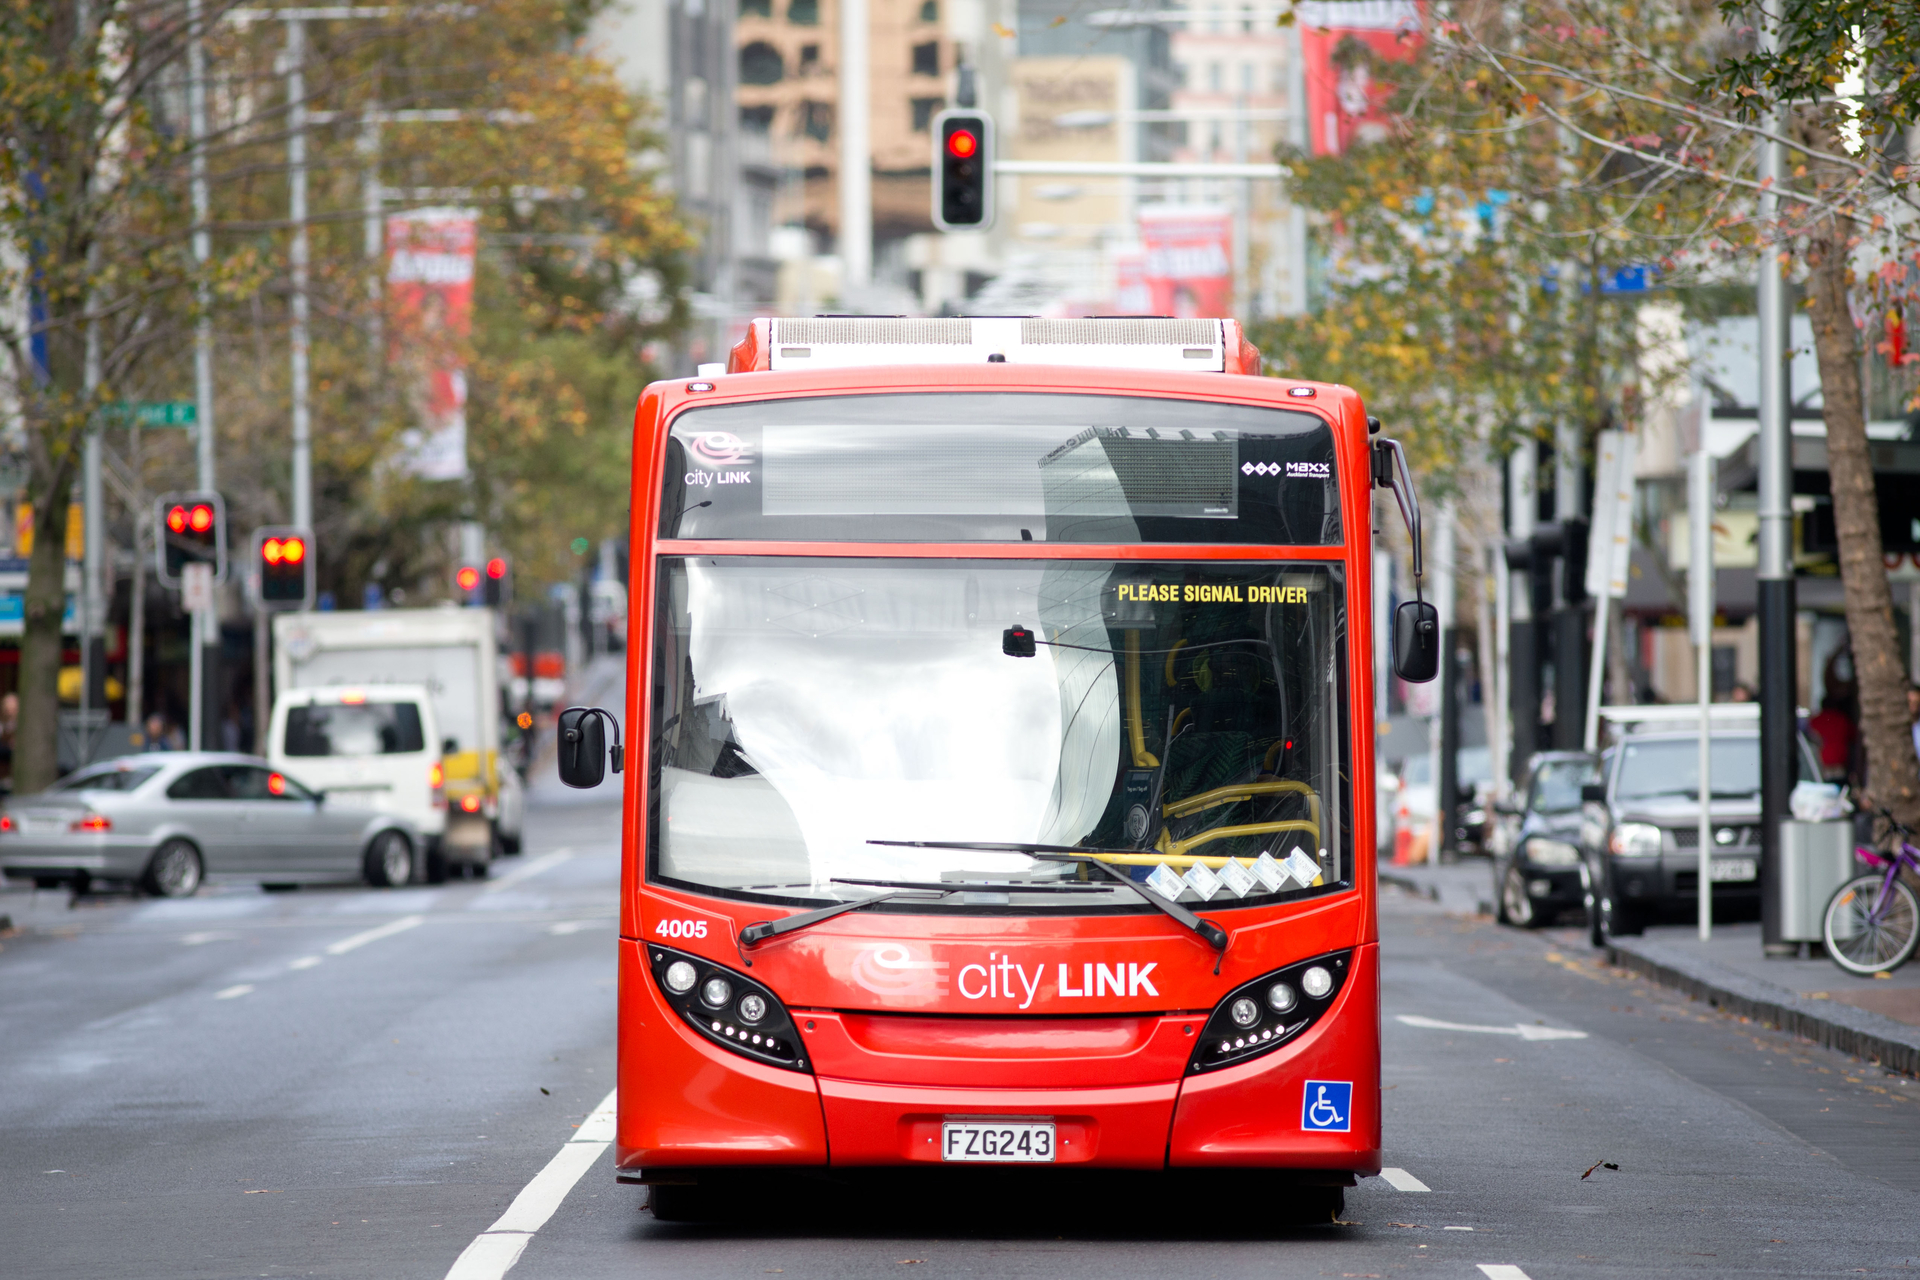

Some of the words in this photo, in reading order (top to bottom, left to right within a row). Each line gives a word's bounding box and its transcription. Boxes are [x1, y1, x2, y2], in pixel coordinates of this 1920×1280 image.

[684, 468, 714, 488] city
[717, 471, 752, 484] LINK
[1118, 584, 1179, 601] PLEASE
[1184, 585, 1243, 602] SIGNAL
[1248, 586, 1308, 603] DRIVER
[655, 919, 708, 939] 4005
[958, 952, 1045, 1009] city
[1058, 963, 1160, 997] LINK
[948, 1129, 1050, 1156] FZG243
